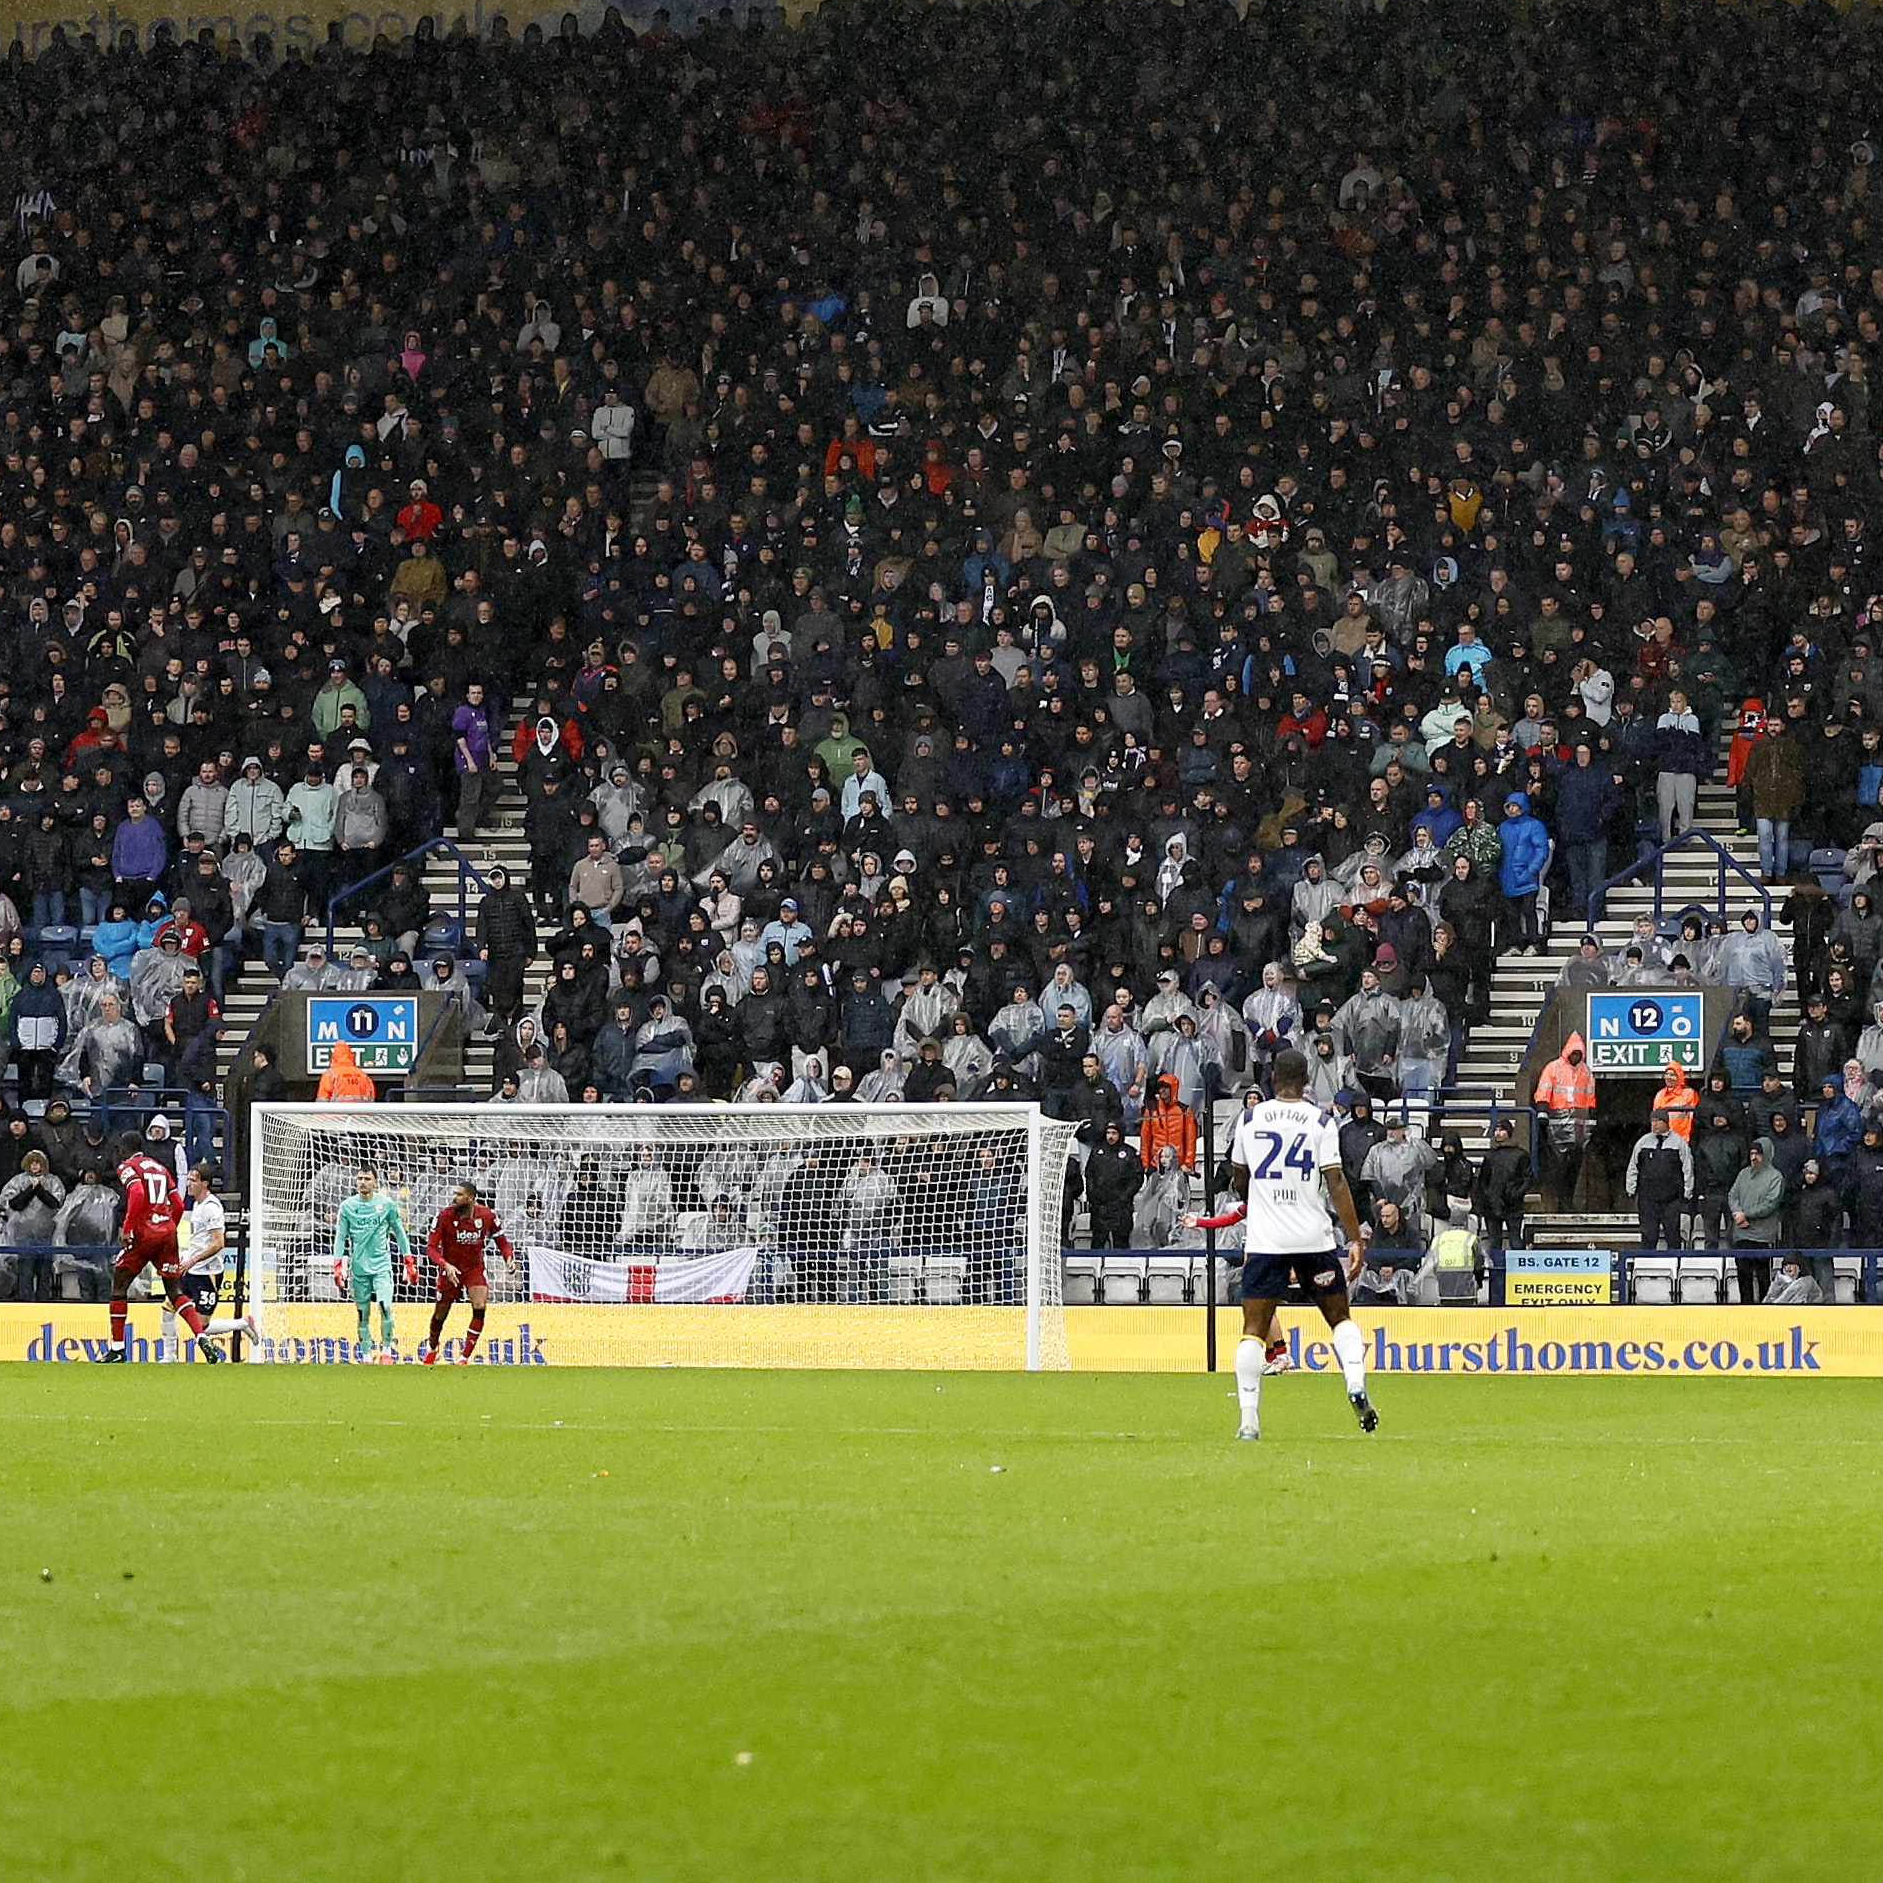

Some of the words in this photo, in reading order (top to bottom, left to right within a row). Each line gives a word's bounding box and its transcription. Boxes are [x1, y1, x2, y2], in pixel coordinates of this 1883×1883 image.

[466, 884, 478, 894] 14
[318, 1022, 337, 1039] M
[352, 1012, 372, 1031] 11
[388, 1021, 405, 1039] N
[1600, 1018, 1619, 1036] N
[1633, 1008, 1657, 1027] 12
[1672, 1017, 1691, 1036] O
[316, 1048, 365, 1066] ET
[1597, 1045, 1649, 1064] EXIT
[1264, 1109, 1309, 1125] OFFIAH
[1254, 1131, 1315, 1182] 24
[143, 1173, 167, 1204] 17
[1518, 1257, 1539, 1267] BS.
[1544, 1257, 1579, 1267] GATE
[1584, 1257, 1599, 1267] 12
[199, 1291, 216, 1305] 38
[1514, 1284, 1602, 1294] EMERGENCY
[28, 1323, 546, 1364] dewhurome.co.uk
